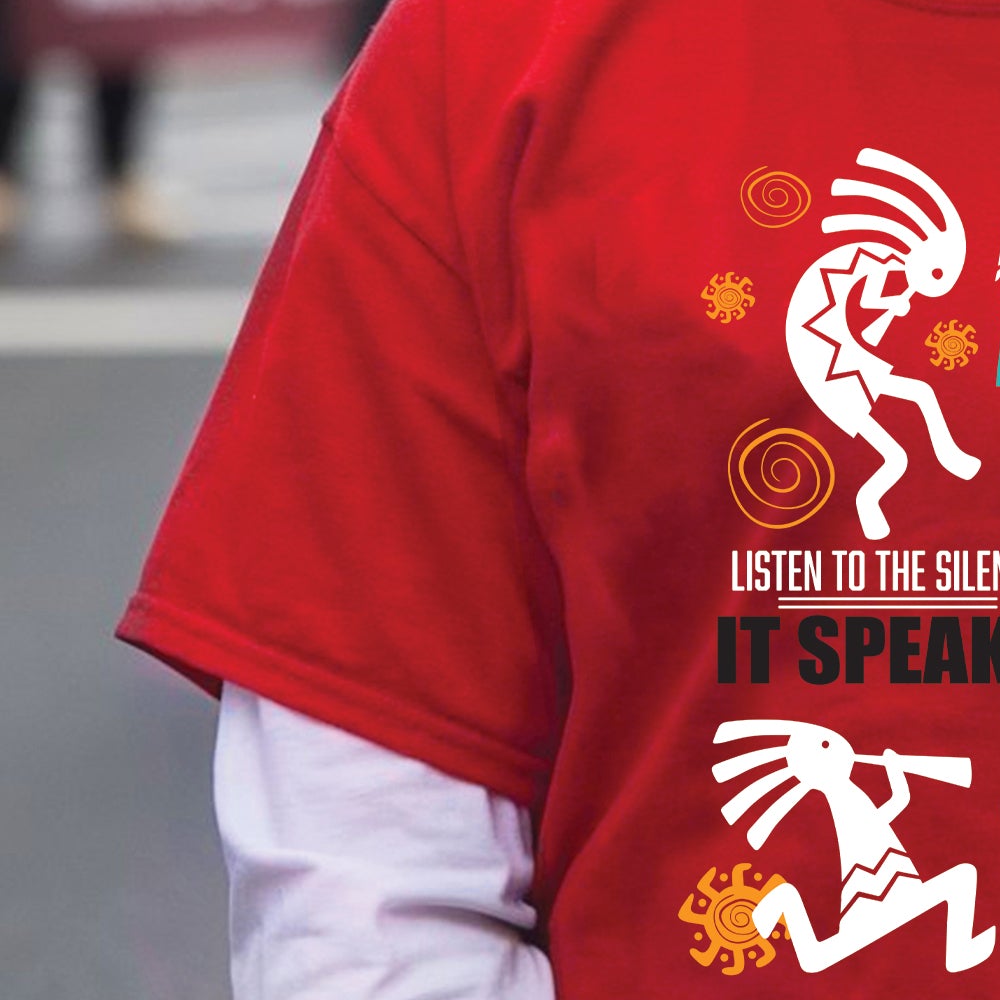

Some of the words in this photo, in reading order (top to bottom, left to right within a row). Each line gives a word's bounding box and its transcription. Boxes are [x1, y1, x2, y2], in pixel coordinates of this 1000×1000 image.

[731, 550, 822, 592] LISTEN
[831, 550, 866, 592] TO
[874, 550, 926, 592] THE
[717, 616, 781, 684] IT
